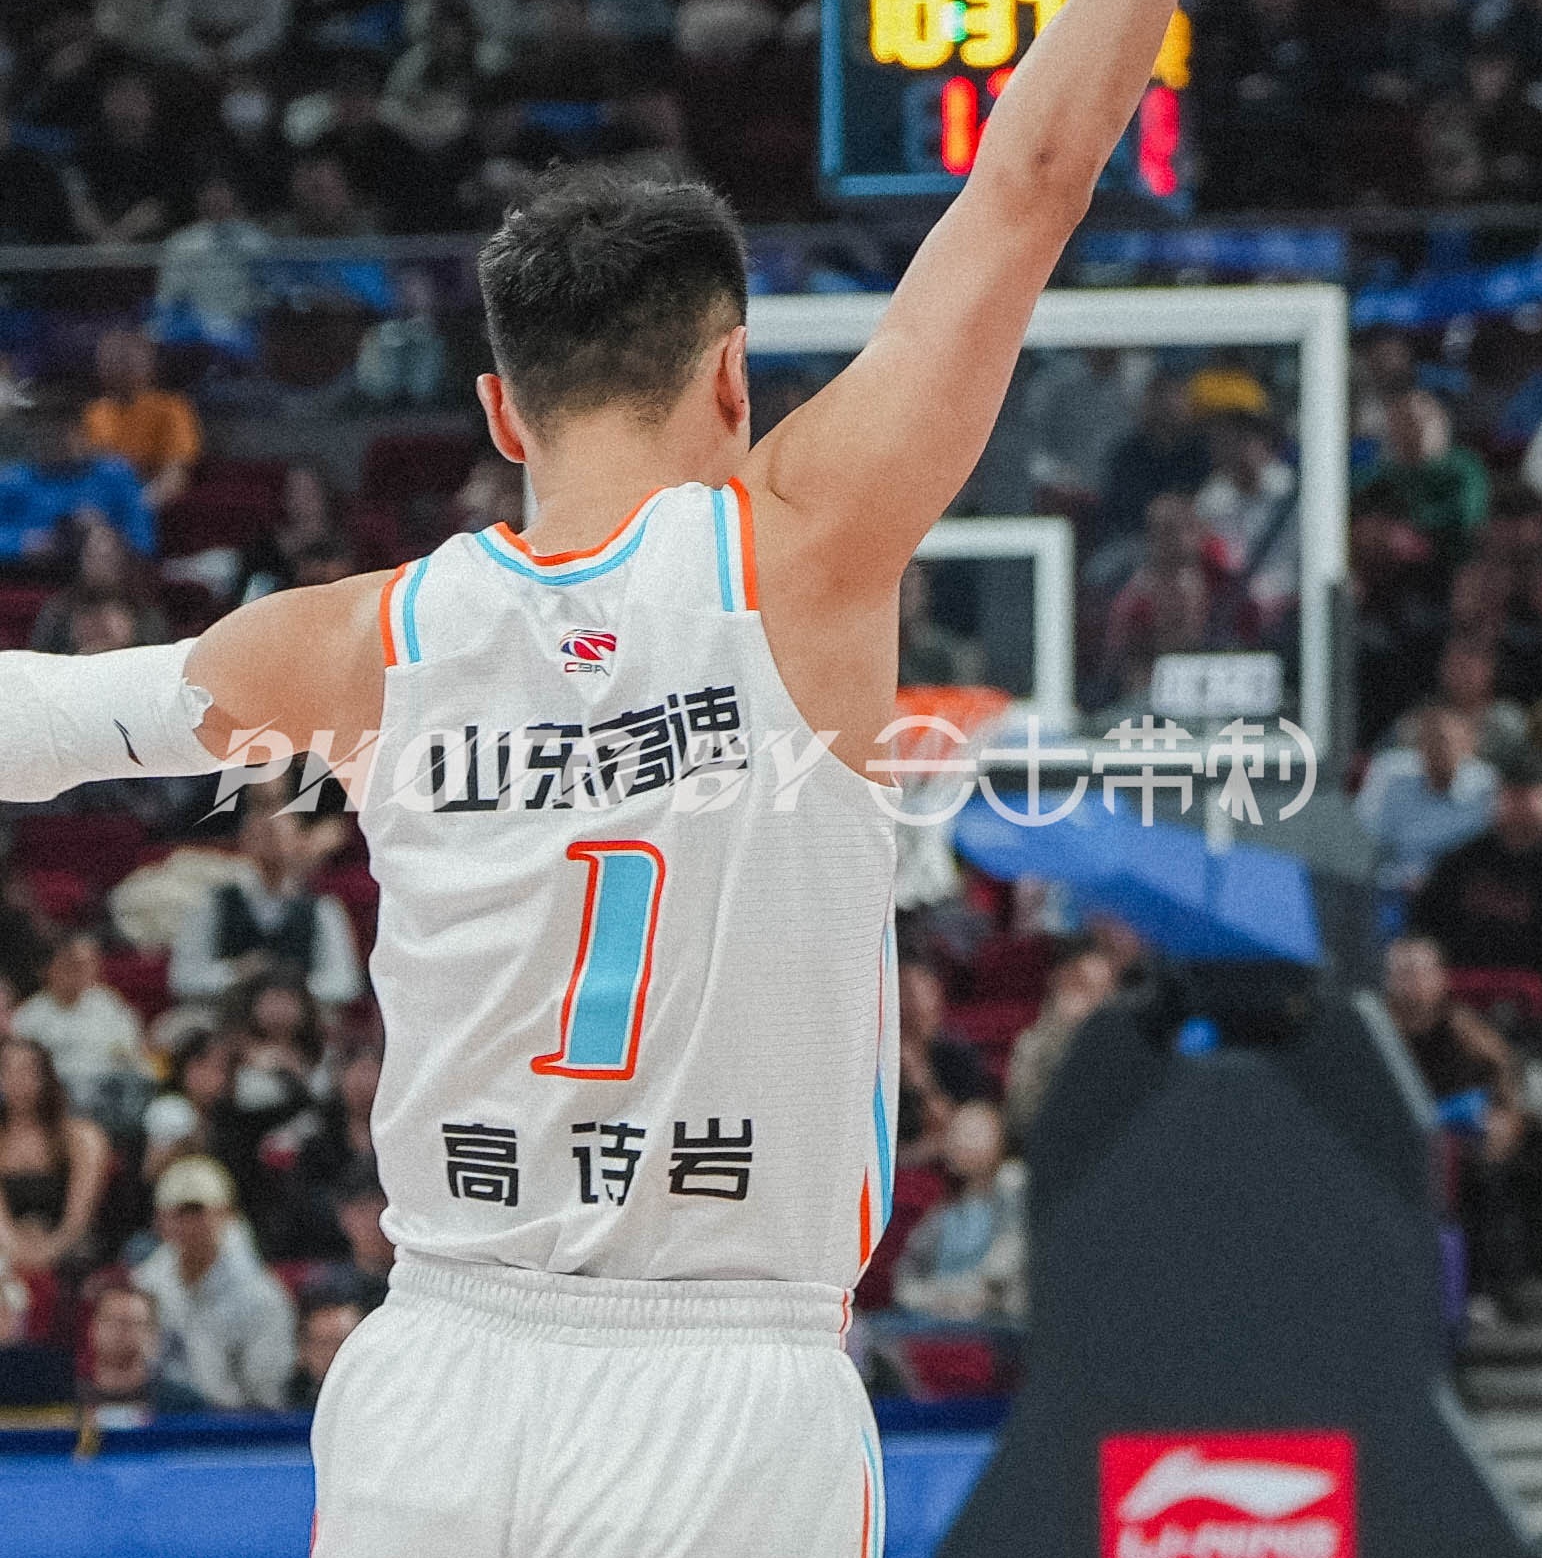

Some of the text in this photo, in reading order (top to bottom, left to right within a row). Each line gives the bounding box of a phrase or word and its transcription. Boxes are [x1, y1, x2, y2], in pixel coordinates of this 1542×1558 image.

[564, 661, 611, 677] CBA
[431, 685, 748, 813] 山东高速
[530, 840, 666, 1080] 1
[440, 1117, 754, 1209] 高诗岩
